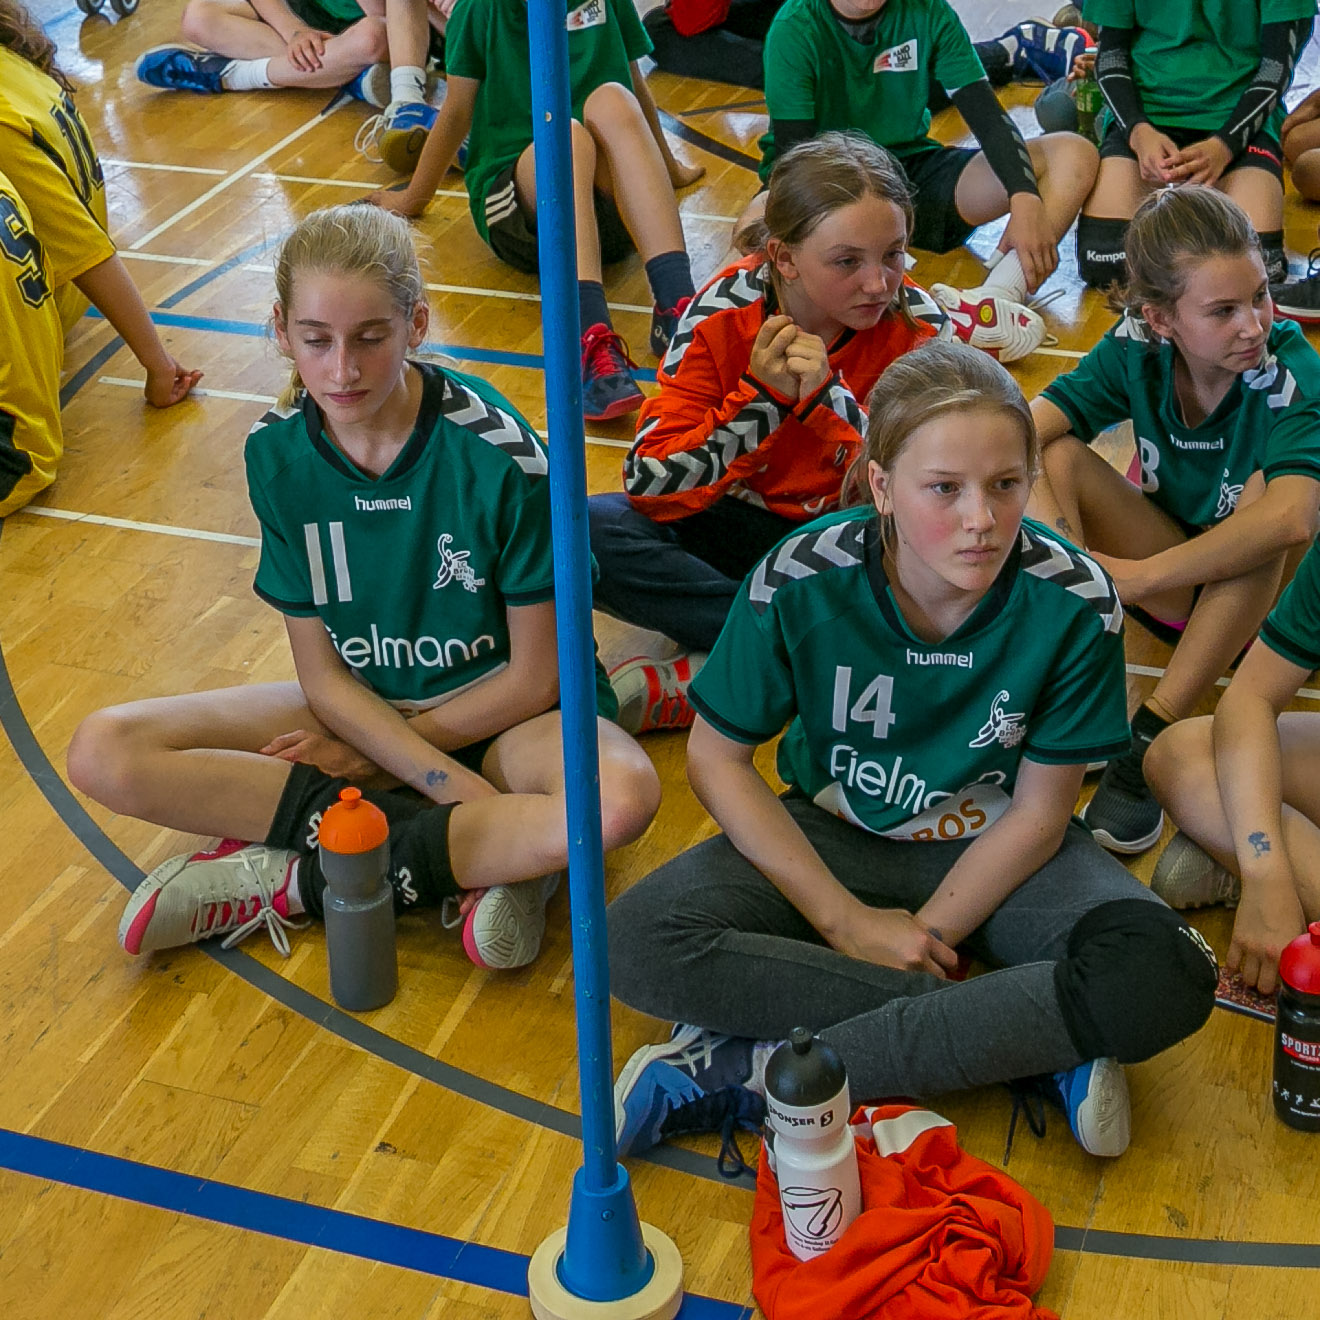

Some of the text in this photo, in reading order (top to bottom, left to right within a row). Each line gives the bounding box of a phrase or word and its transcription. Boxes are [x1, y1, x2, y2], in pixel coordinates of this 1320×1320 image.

[1086, 249, 1127, 264] Kempa
[1169, 433, 1224, 450] hummel
[354, 495, 412, 511] hummel
[303, 521, 353, 606] 11
[326, 623, 496, 669] ielmann
[906, 648, 973, 669] hummel
[831, 665, 896, 740] 14
